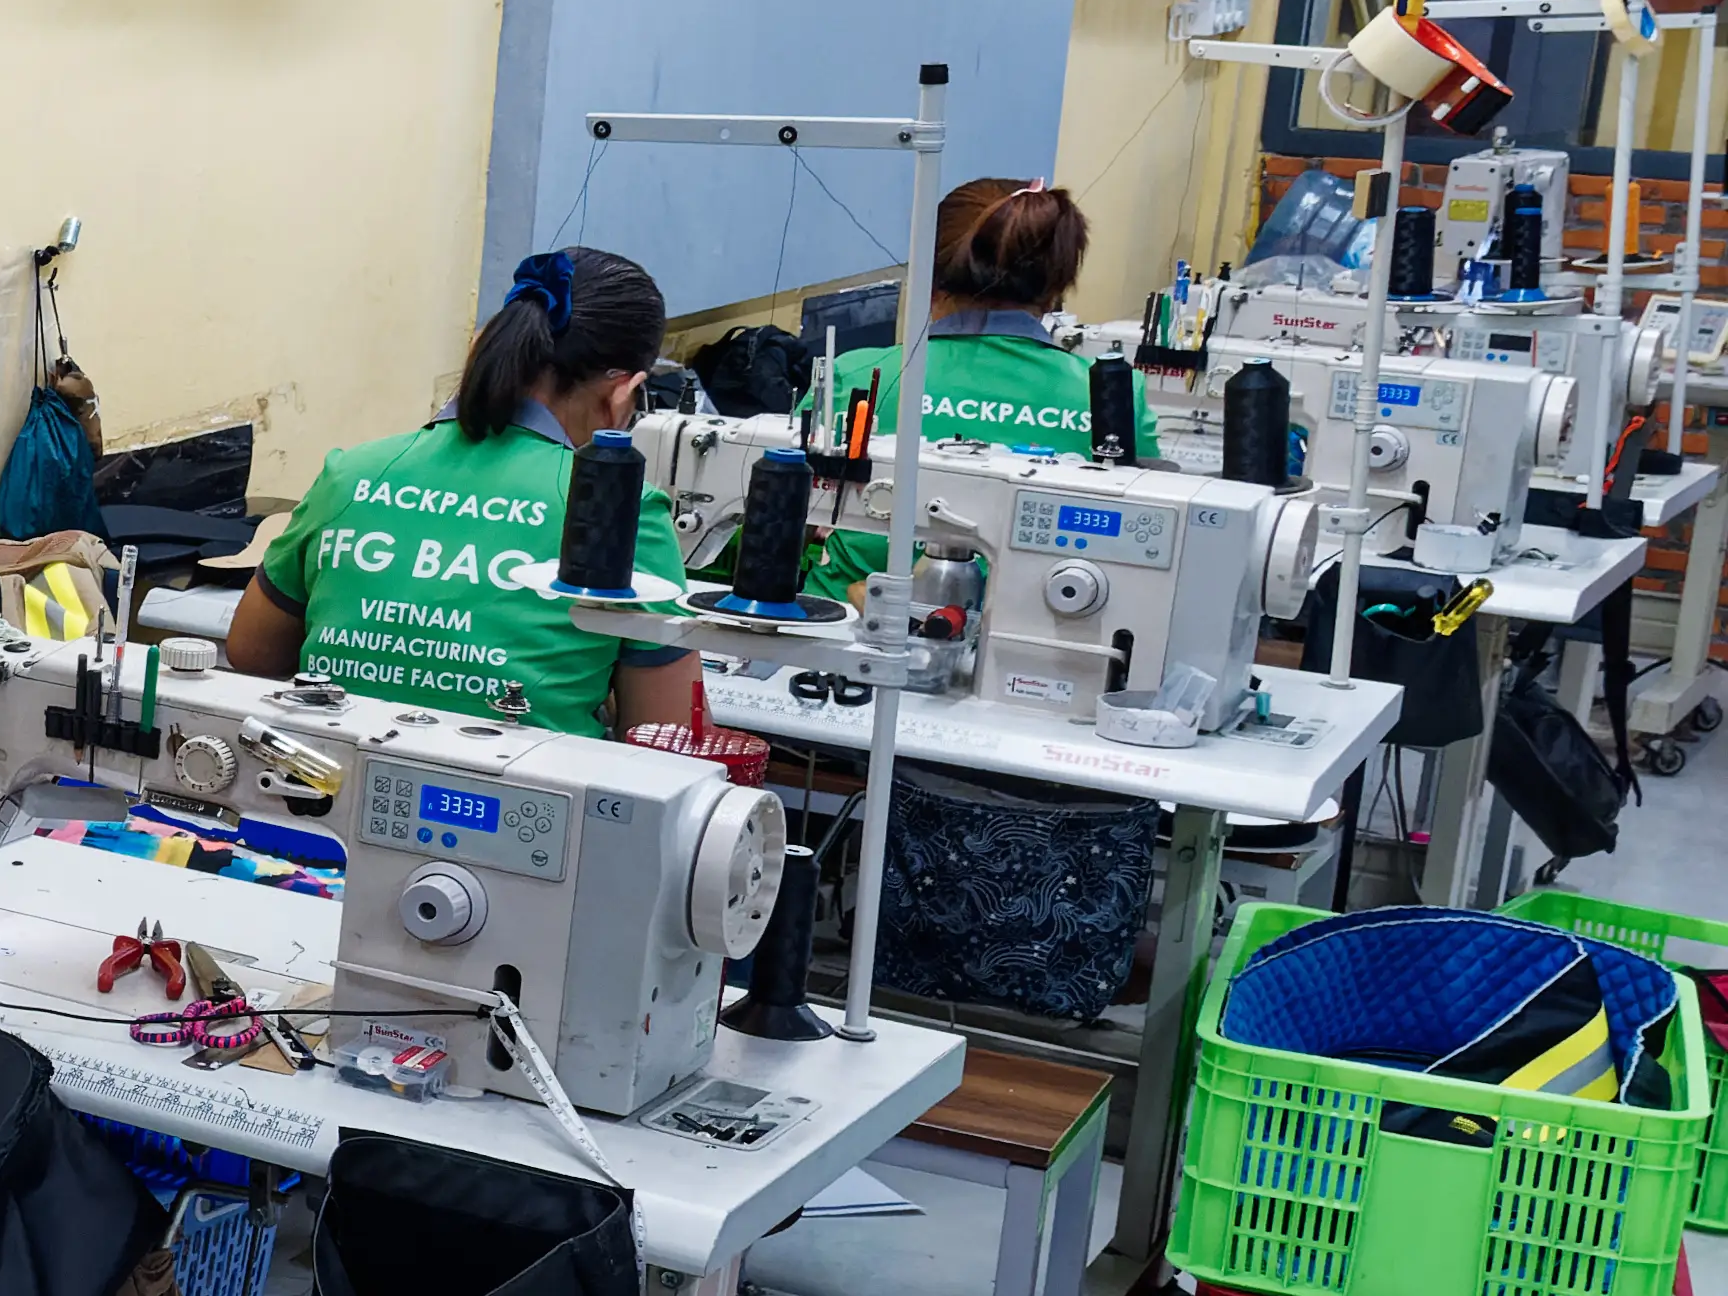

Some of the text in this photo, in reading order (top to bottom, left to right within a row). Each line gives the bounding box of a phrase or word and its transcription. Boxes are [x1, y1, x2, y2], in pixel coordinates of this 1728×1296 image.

[921, 393, 1092, 433] BACKPACKS
[353, 478, 547, 527] BACKPACKS
[317, 528, 395, 572] FFG
[360, 597, 472, 633] VIETNAM
[318, 626, 508, 667] MANUFACTURING
[307, 654, 405, 685] BOUTIQUE
[440, 794, 486, 819] 3333
